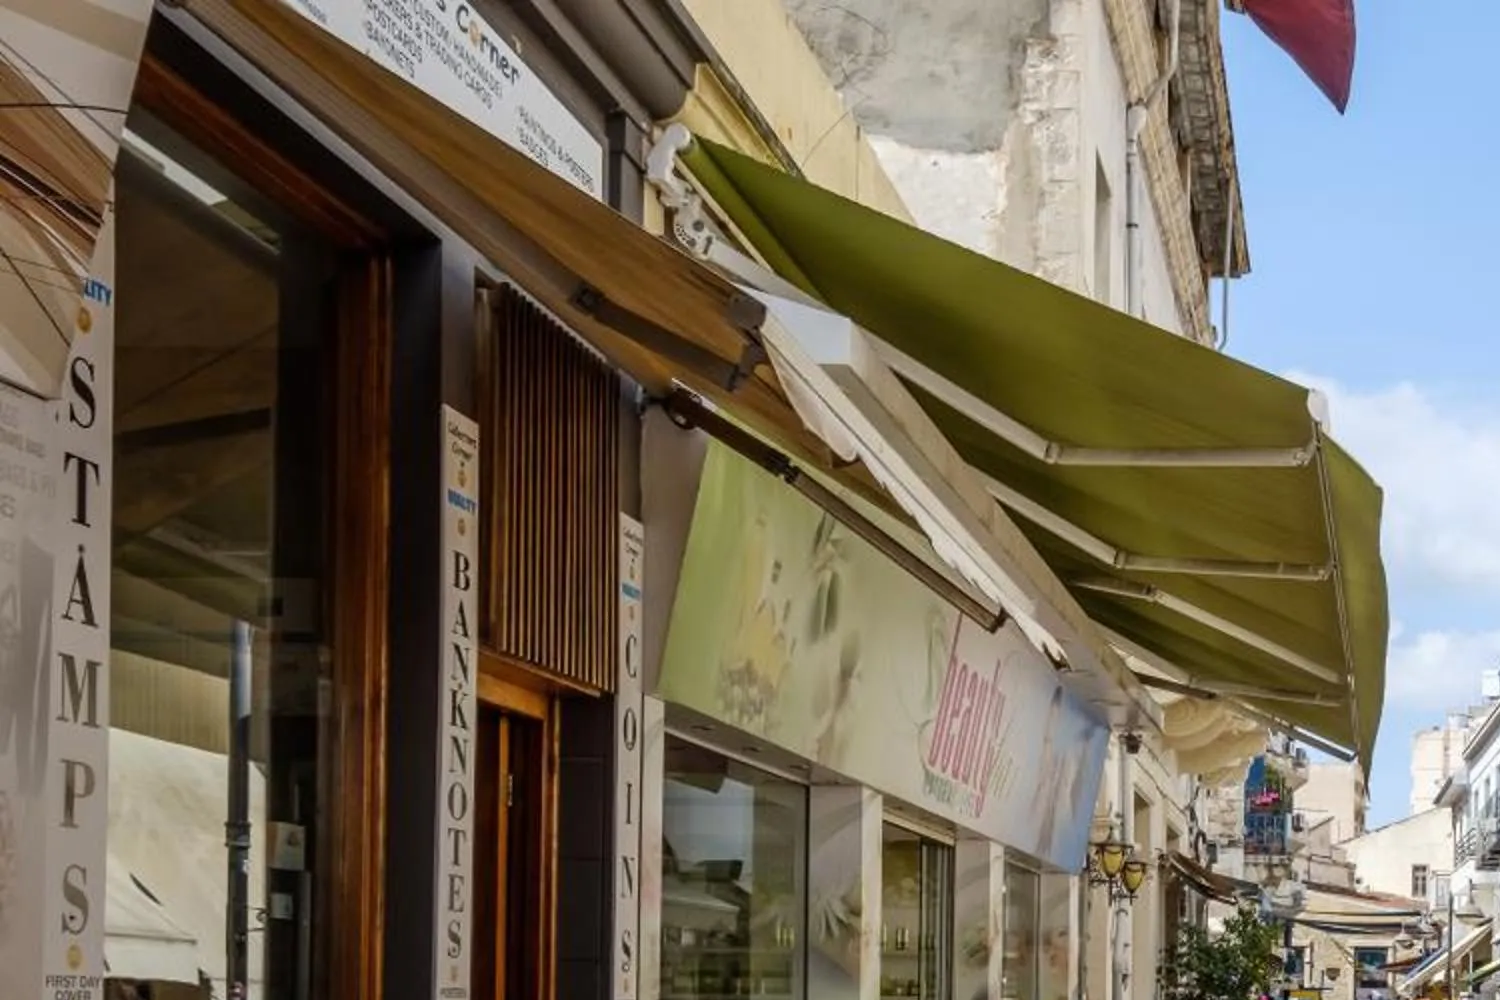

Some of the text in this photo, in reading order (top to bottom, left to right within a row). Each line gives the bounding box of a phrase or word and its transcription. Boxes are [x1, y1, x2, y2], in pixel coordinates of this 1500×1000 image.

[455, 4, 521, 85] Corner
[55, 356, 103, 936] STAMPS
[447, 549, 472, 961] BANKNOTES
[927, 614, 1006, 820] beauty
[621, 633, 638, 974] COINS
[46, 975, 101, 989] FIRST DAY
